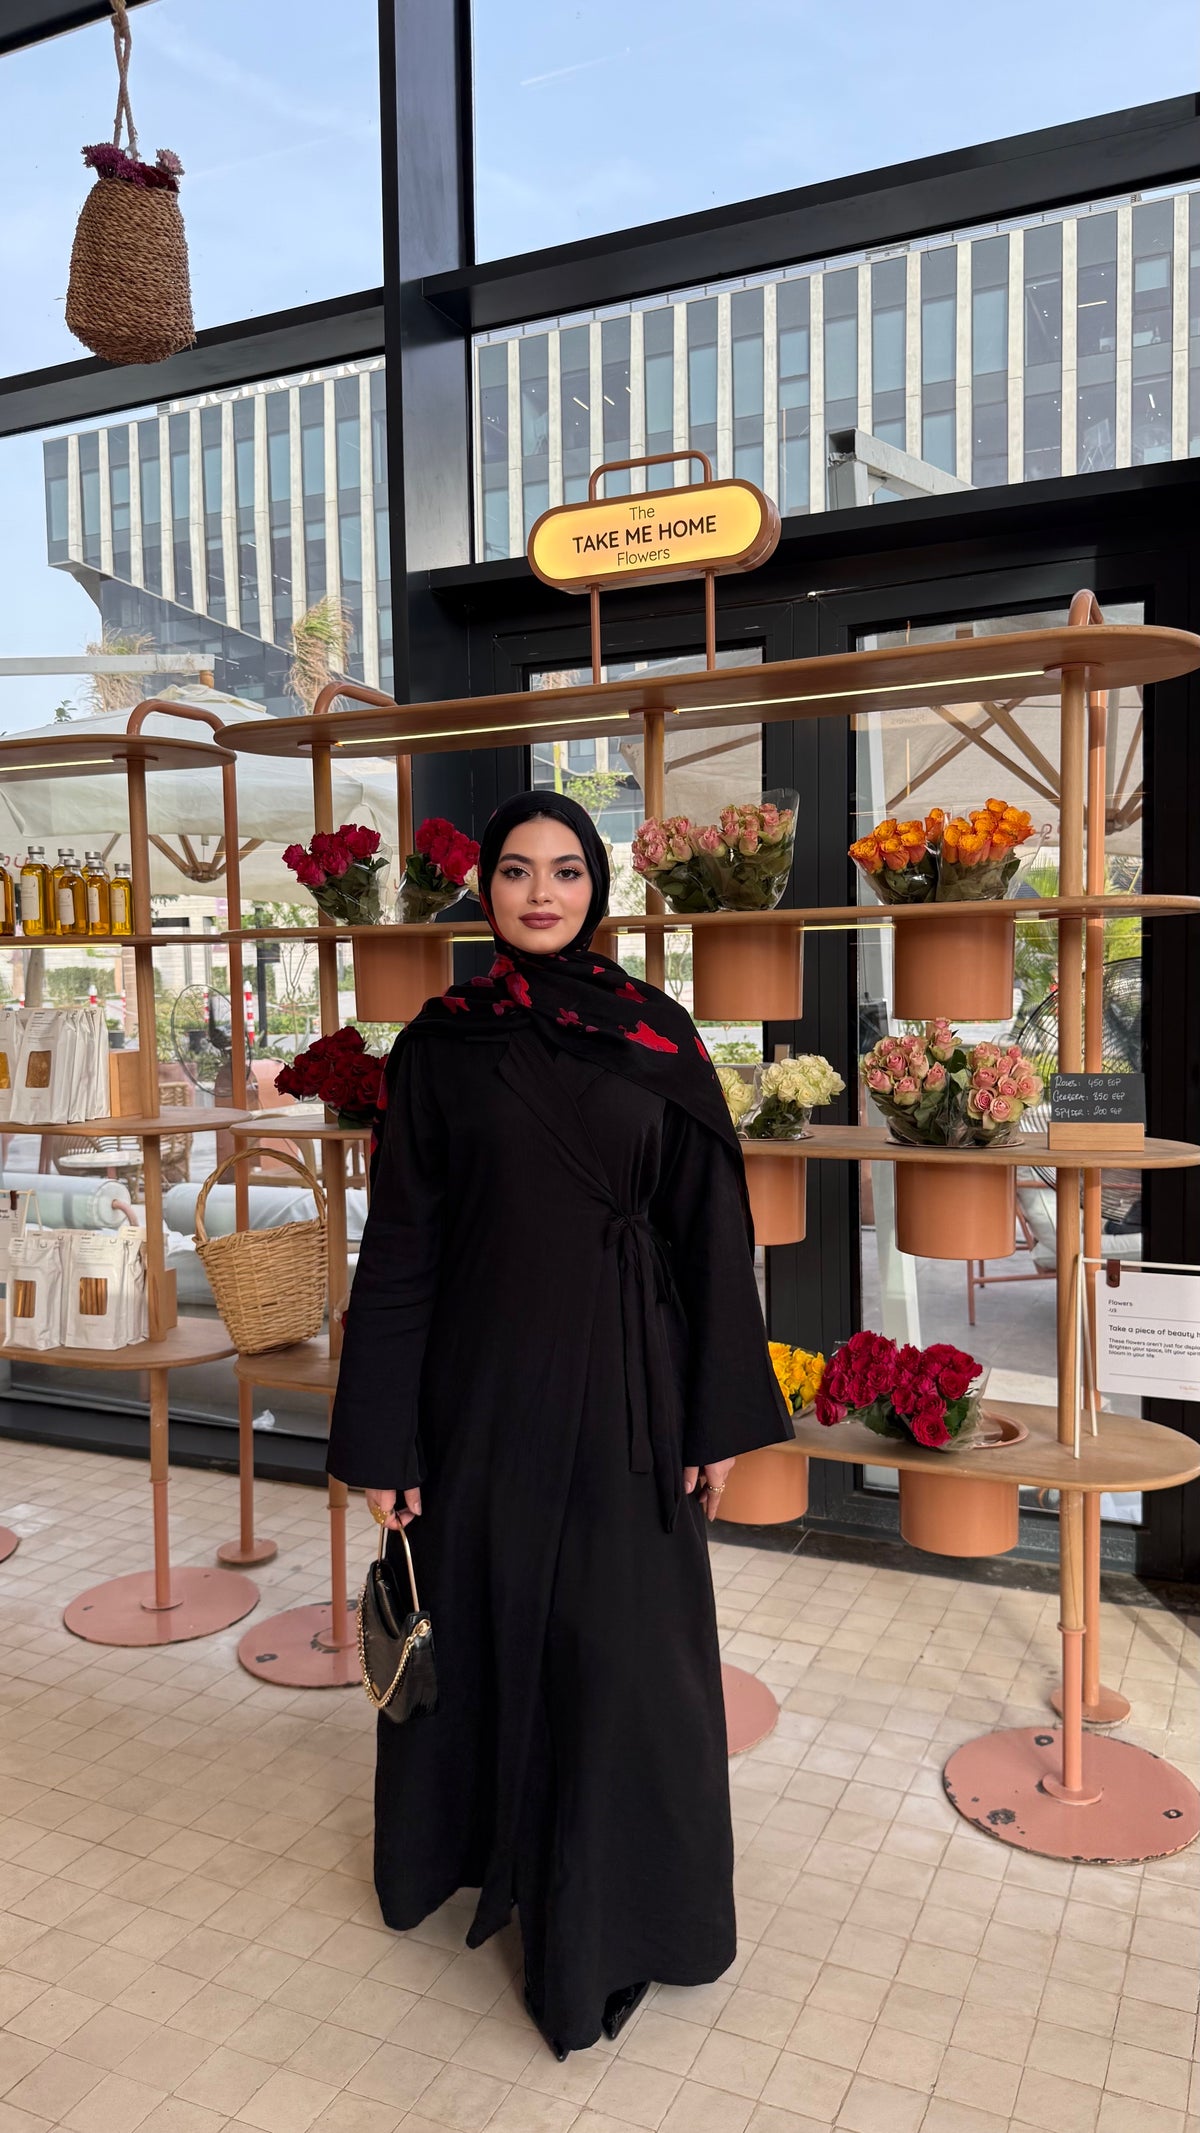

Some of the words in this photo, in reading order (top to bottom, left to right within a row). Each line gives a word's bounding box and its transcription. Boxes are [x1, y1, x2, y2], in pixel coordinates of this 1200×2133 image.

[629, 505, 655, 521] The
[572, 530, 619, 554] TAKE
[625, 525, 652, 546] ME
[659, 515, 717, 541] HOME
[617, 547, 670, 566] Flowers
[1088, 1078, 1103, 1088] 450
[1092, 1091, 1108, 1101] 350
[1093, 1106, 1107, 1116] 200
[1108, 1299, 1133, 1307] Flowers
[1108, 1325, 1126, 1333] Take
[1135, 1327, 1155, 1335] piece
[1156, 1328, 1166, 1336] of
[1167, 1329, 1195, 1339] beauty
